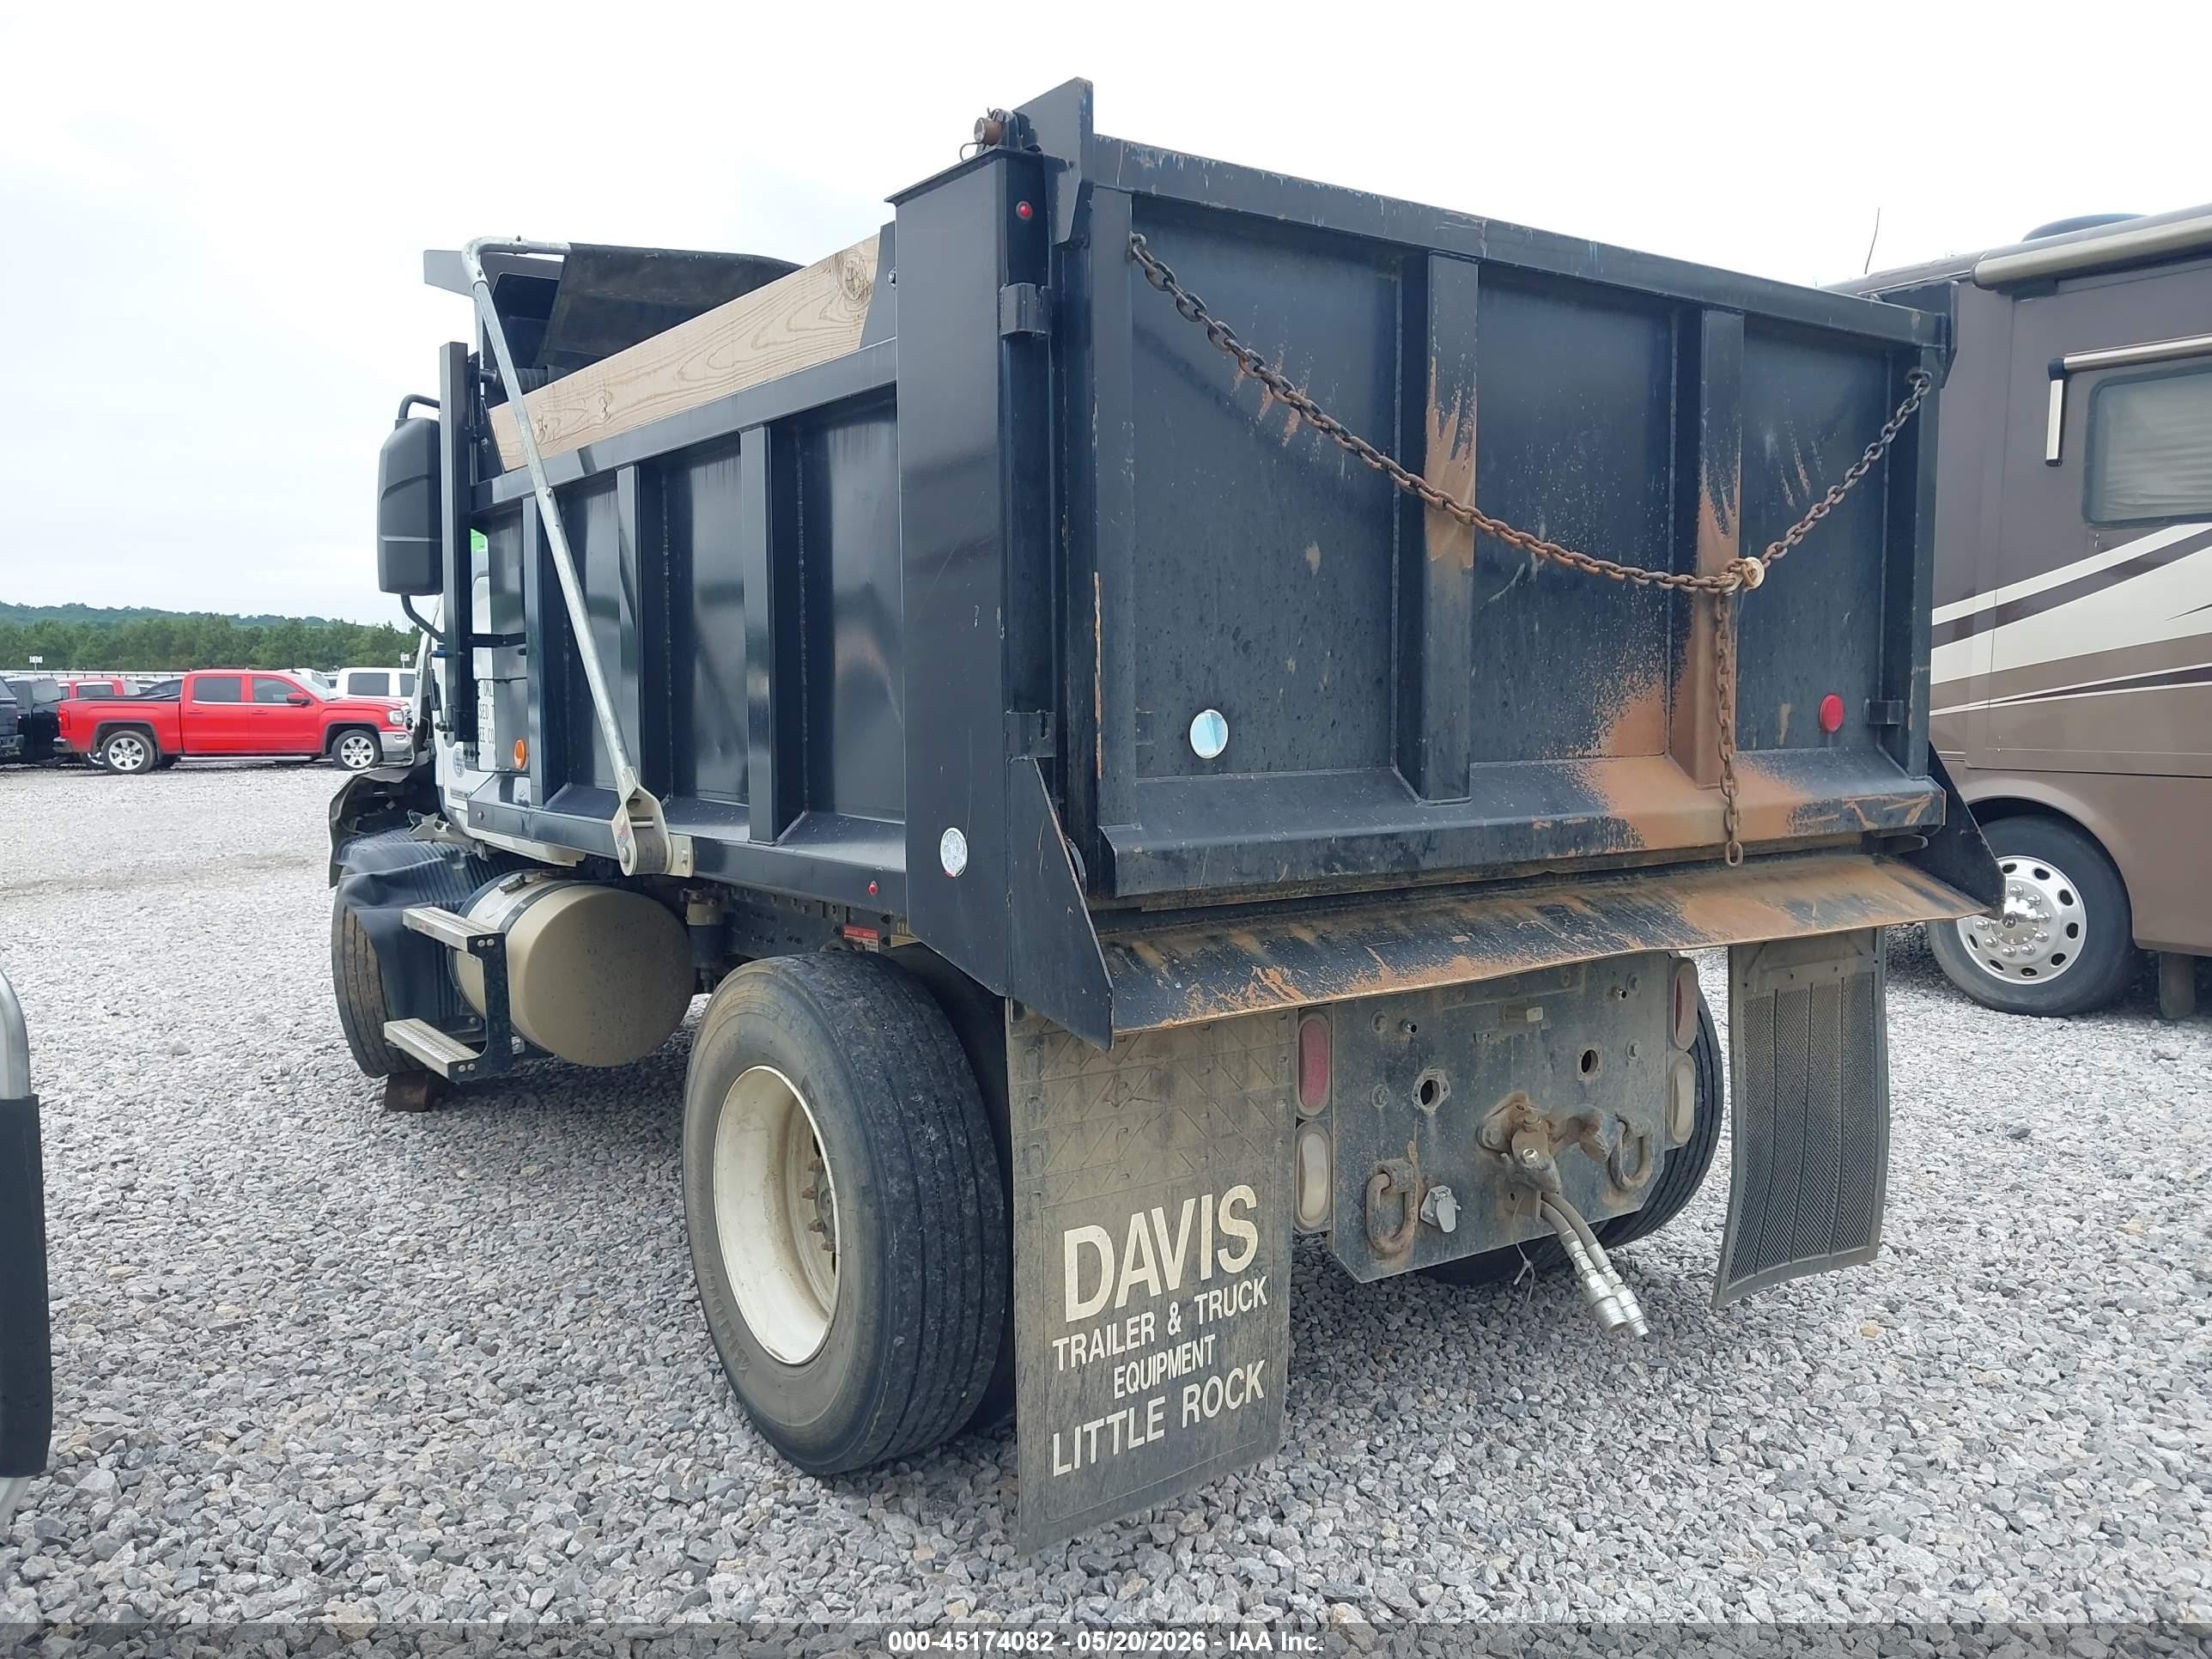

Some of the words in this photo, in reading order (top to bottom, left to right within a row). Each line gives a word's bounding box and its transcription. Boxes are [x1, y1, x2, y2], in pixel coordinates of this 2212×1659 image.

[1064, 1184, 1259, 1323] DAVIS
[1052, 1310, 1156, 1372] TRAILER
[1167, 1301, 1182, 1336] &
[1194, 1276, 1268, 1326] TRUCK
[1114, 1334, 1216, 1401] EQUIPMENT
[1053, 1395, 1166, 1478] LITTLE
[1182, 1359, 1267, 1429] ROCK
